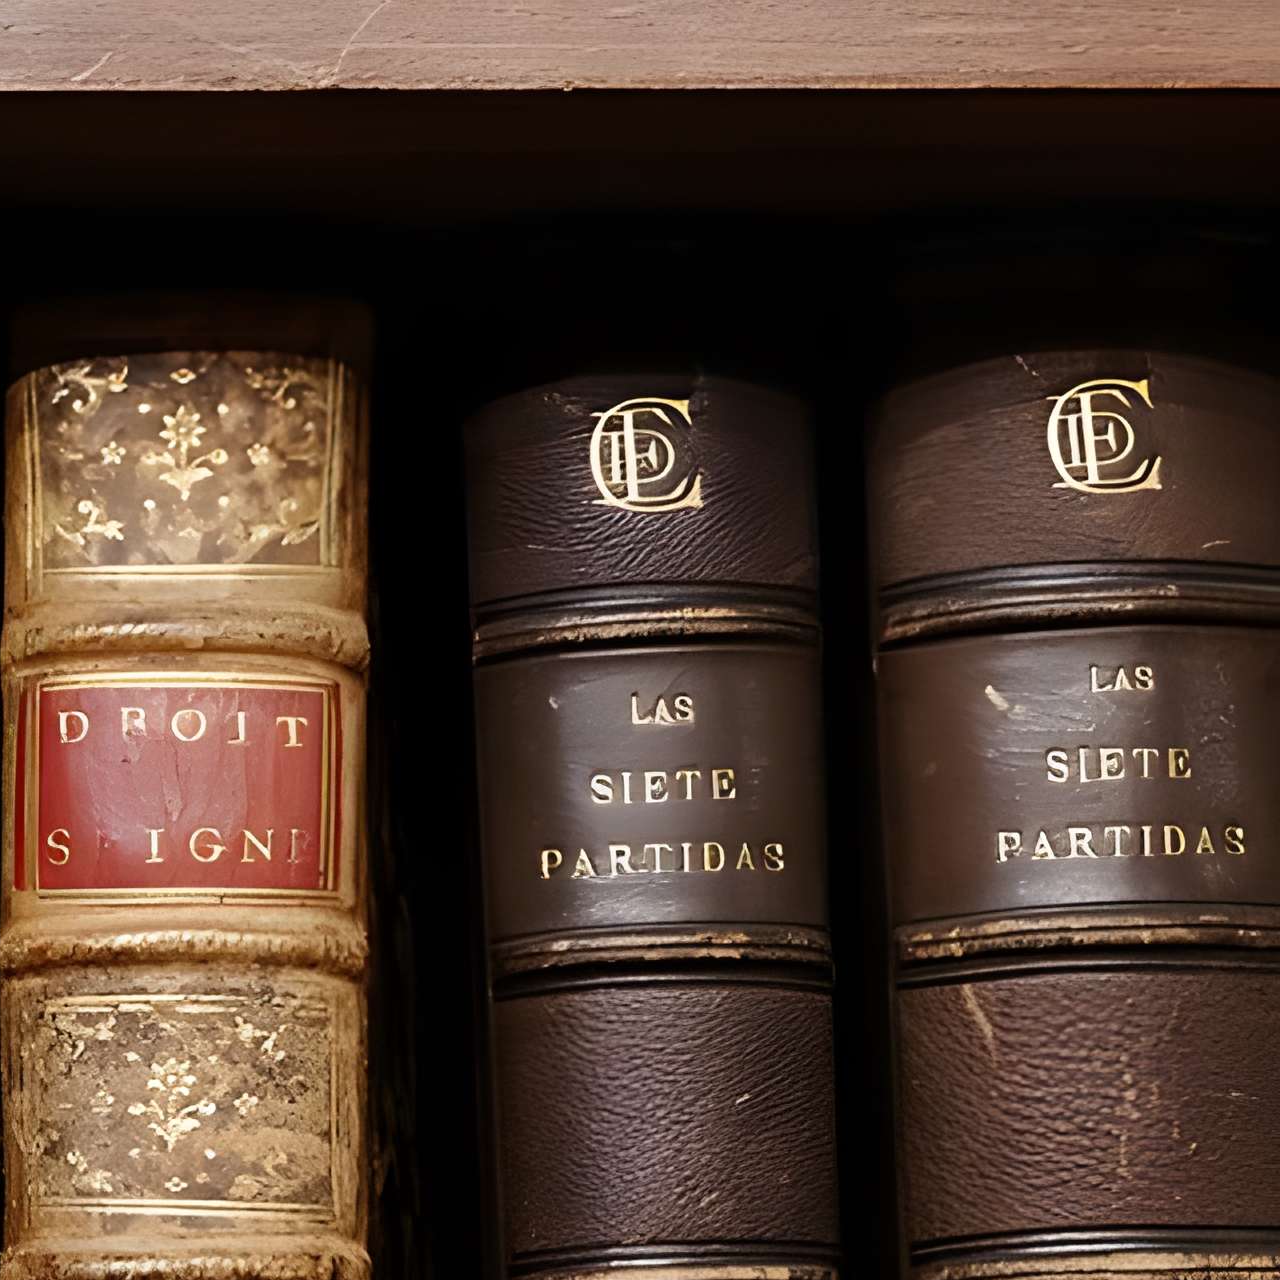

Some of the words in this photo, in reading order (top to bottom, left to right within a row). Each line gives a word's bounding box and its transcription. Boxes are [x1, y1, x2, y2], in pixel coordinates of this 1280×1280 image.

[1091, 665, 1155, 694] LAS
[57, 705, 309, 748] DROIT
[631, 694, 694, 725] LAS
[1046, 748, 1192, 784] SIETE
[589, 769, 737, 805] SIETE
[540, 842, 786, 880] PARTIDAS
[996, 825, 1246, 864] PARTIDAS
